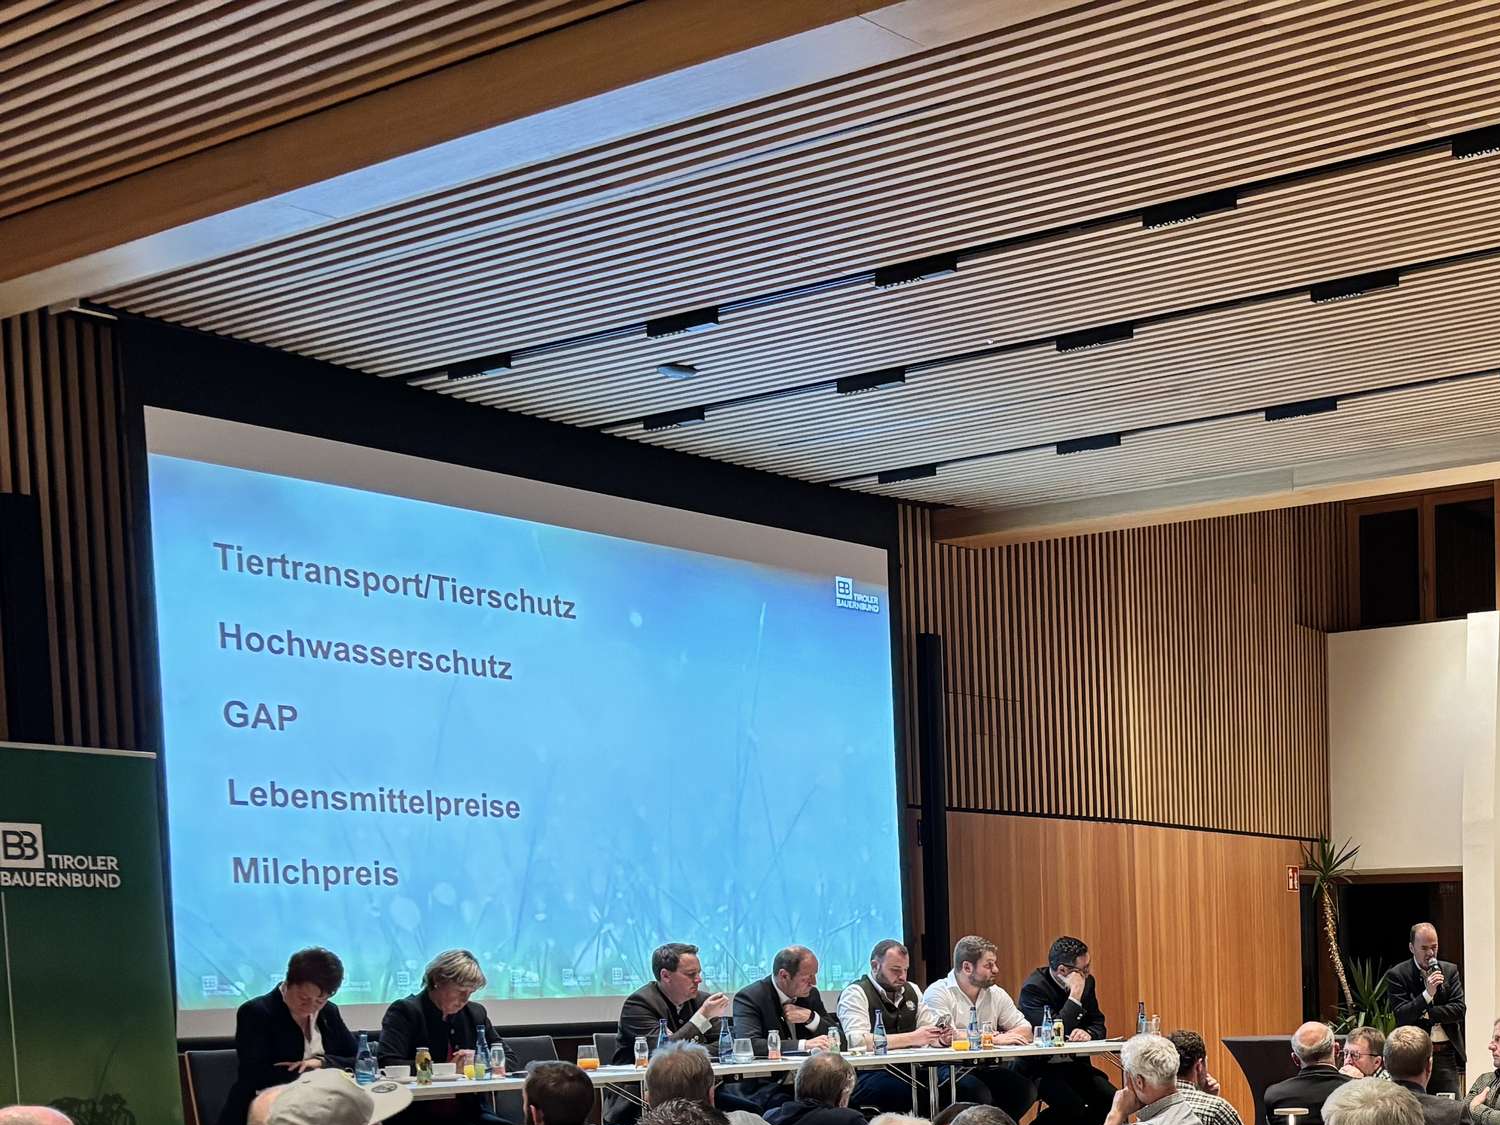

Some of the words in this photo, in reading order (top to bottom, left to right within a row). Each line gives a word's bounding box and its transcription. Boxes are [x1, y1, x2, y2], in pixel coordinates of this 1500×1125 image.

[213, 542, 577, 619] Tiertransport/Tierschutz
[219, 622, 513, 680] Hochwasserschutz
[223, 700, 298, 731] GAP
[229, 779, 520, 821] Lebensmittelpreise
[0, 871, 121, 888] BAUERNBUND
[47, 854, 119, 871] TIROLER
[232, 857, 399, 891] Milchpreis
